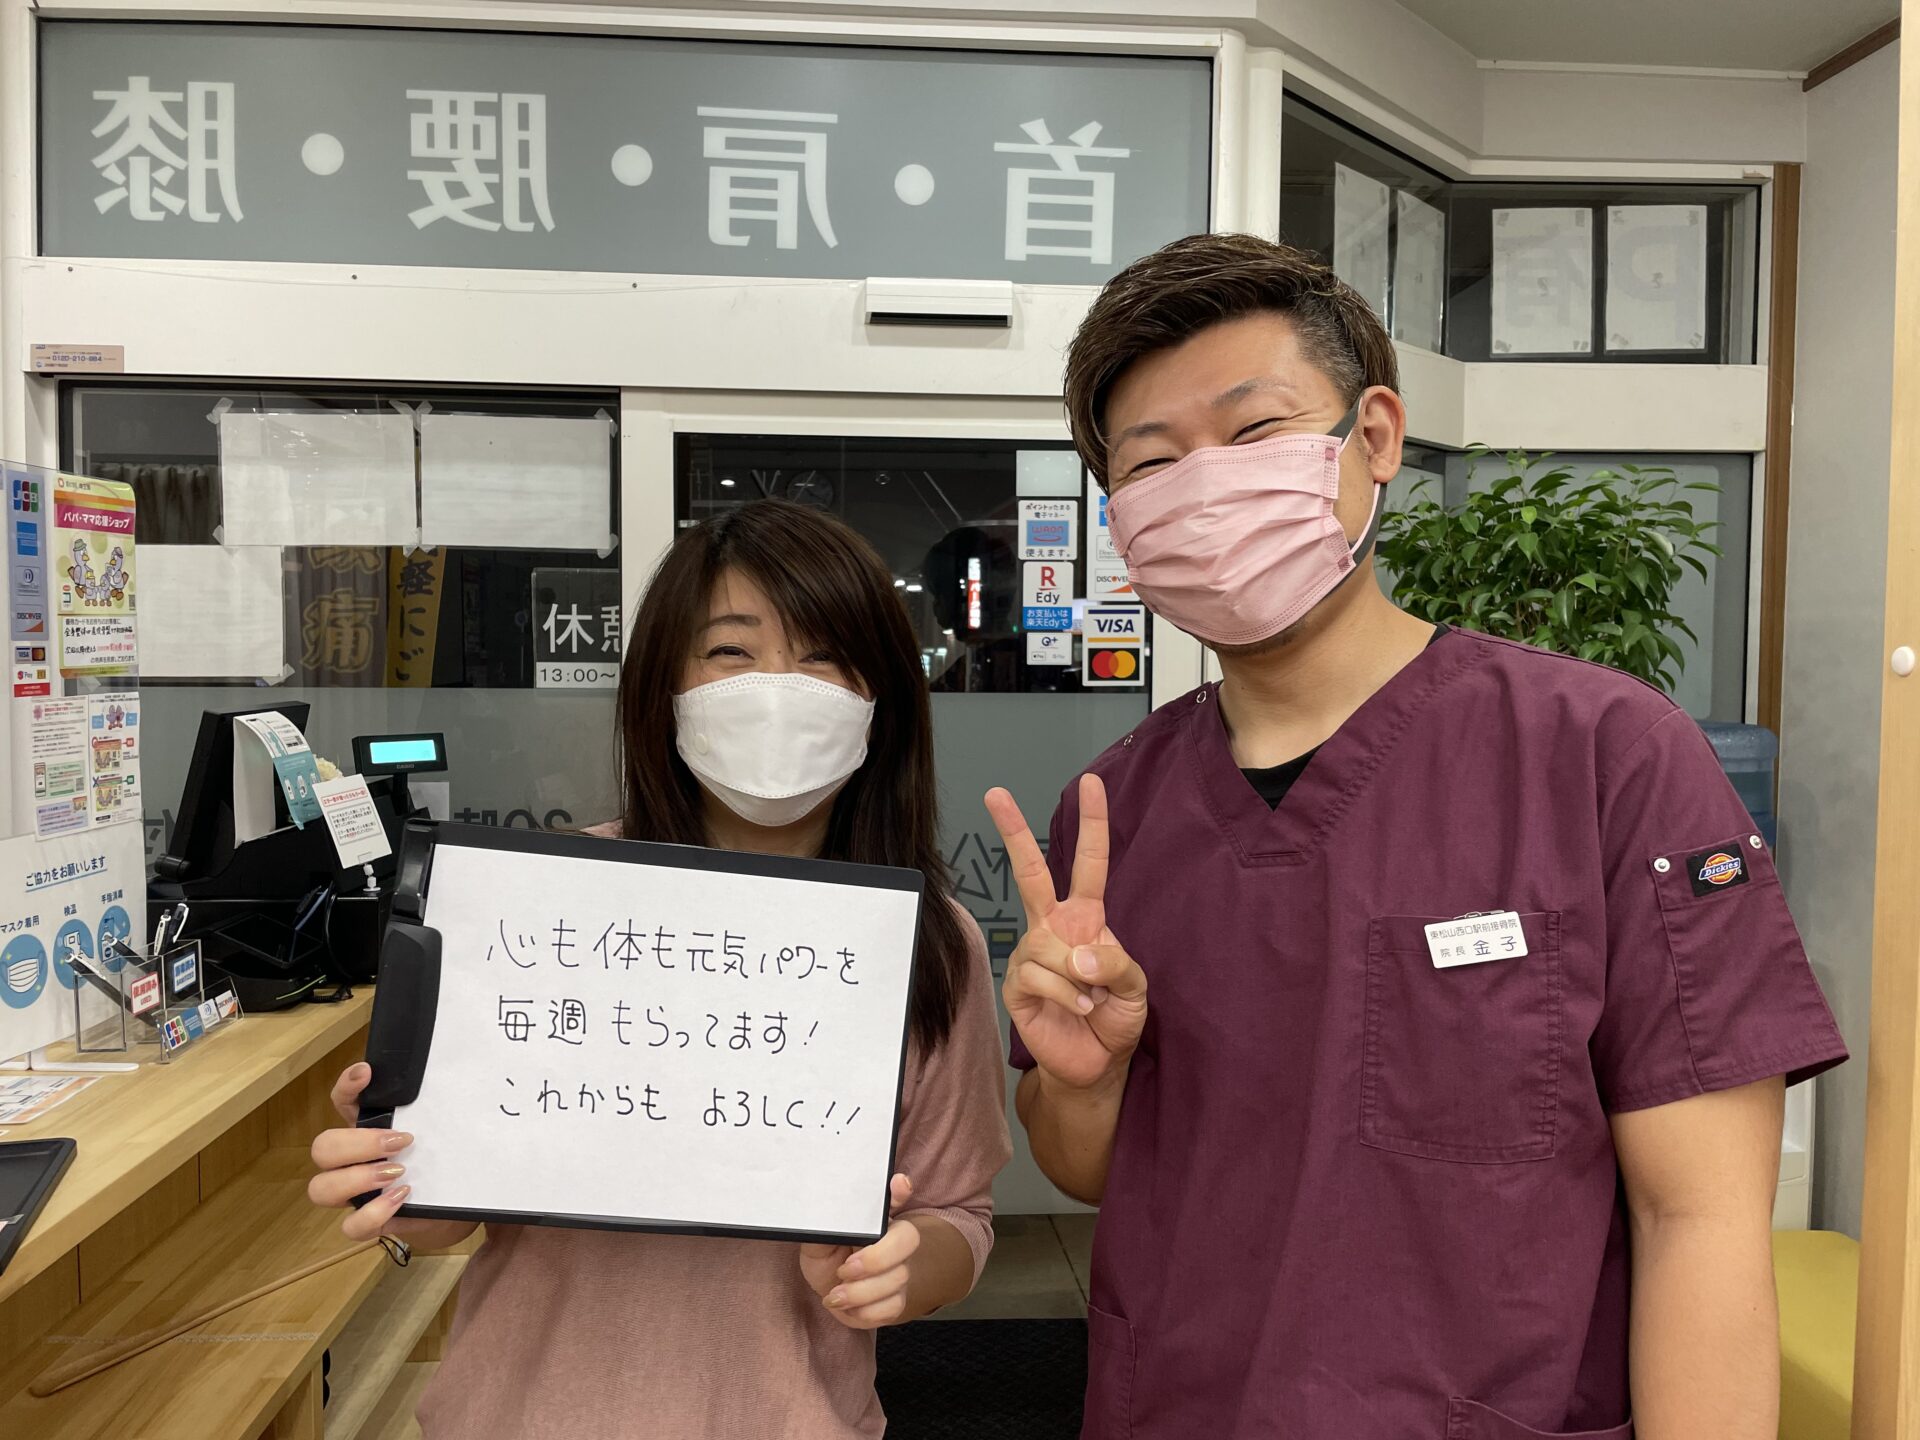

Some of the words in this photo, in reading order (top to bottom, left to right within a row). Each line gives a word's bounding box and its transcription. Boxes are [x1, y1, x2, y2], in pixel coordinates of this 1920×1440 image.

[1036, 592, 1060, 605] Edy
[1026, 609, 1069, 618] お支払いは
[1094, 619, 1135, 633] VISA
[25, 855, 107, 888] ご協力をお願いします
[1703, 861, 1739, 878] Dickies
[0, 914, 41, 934] マスク着用
